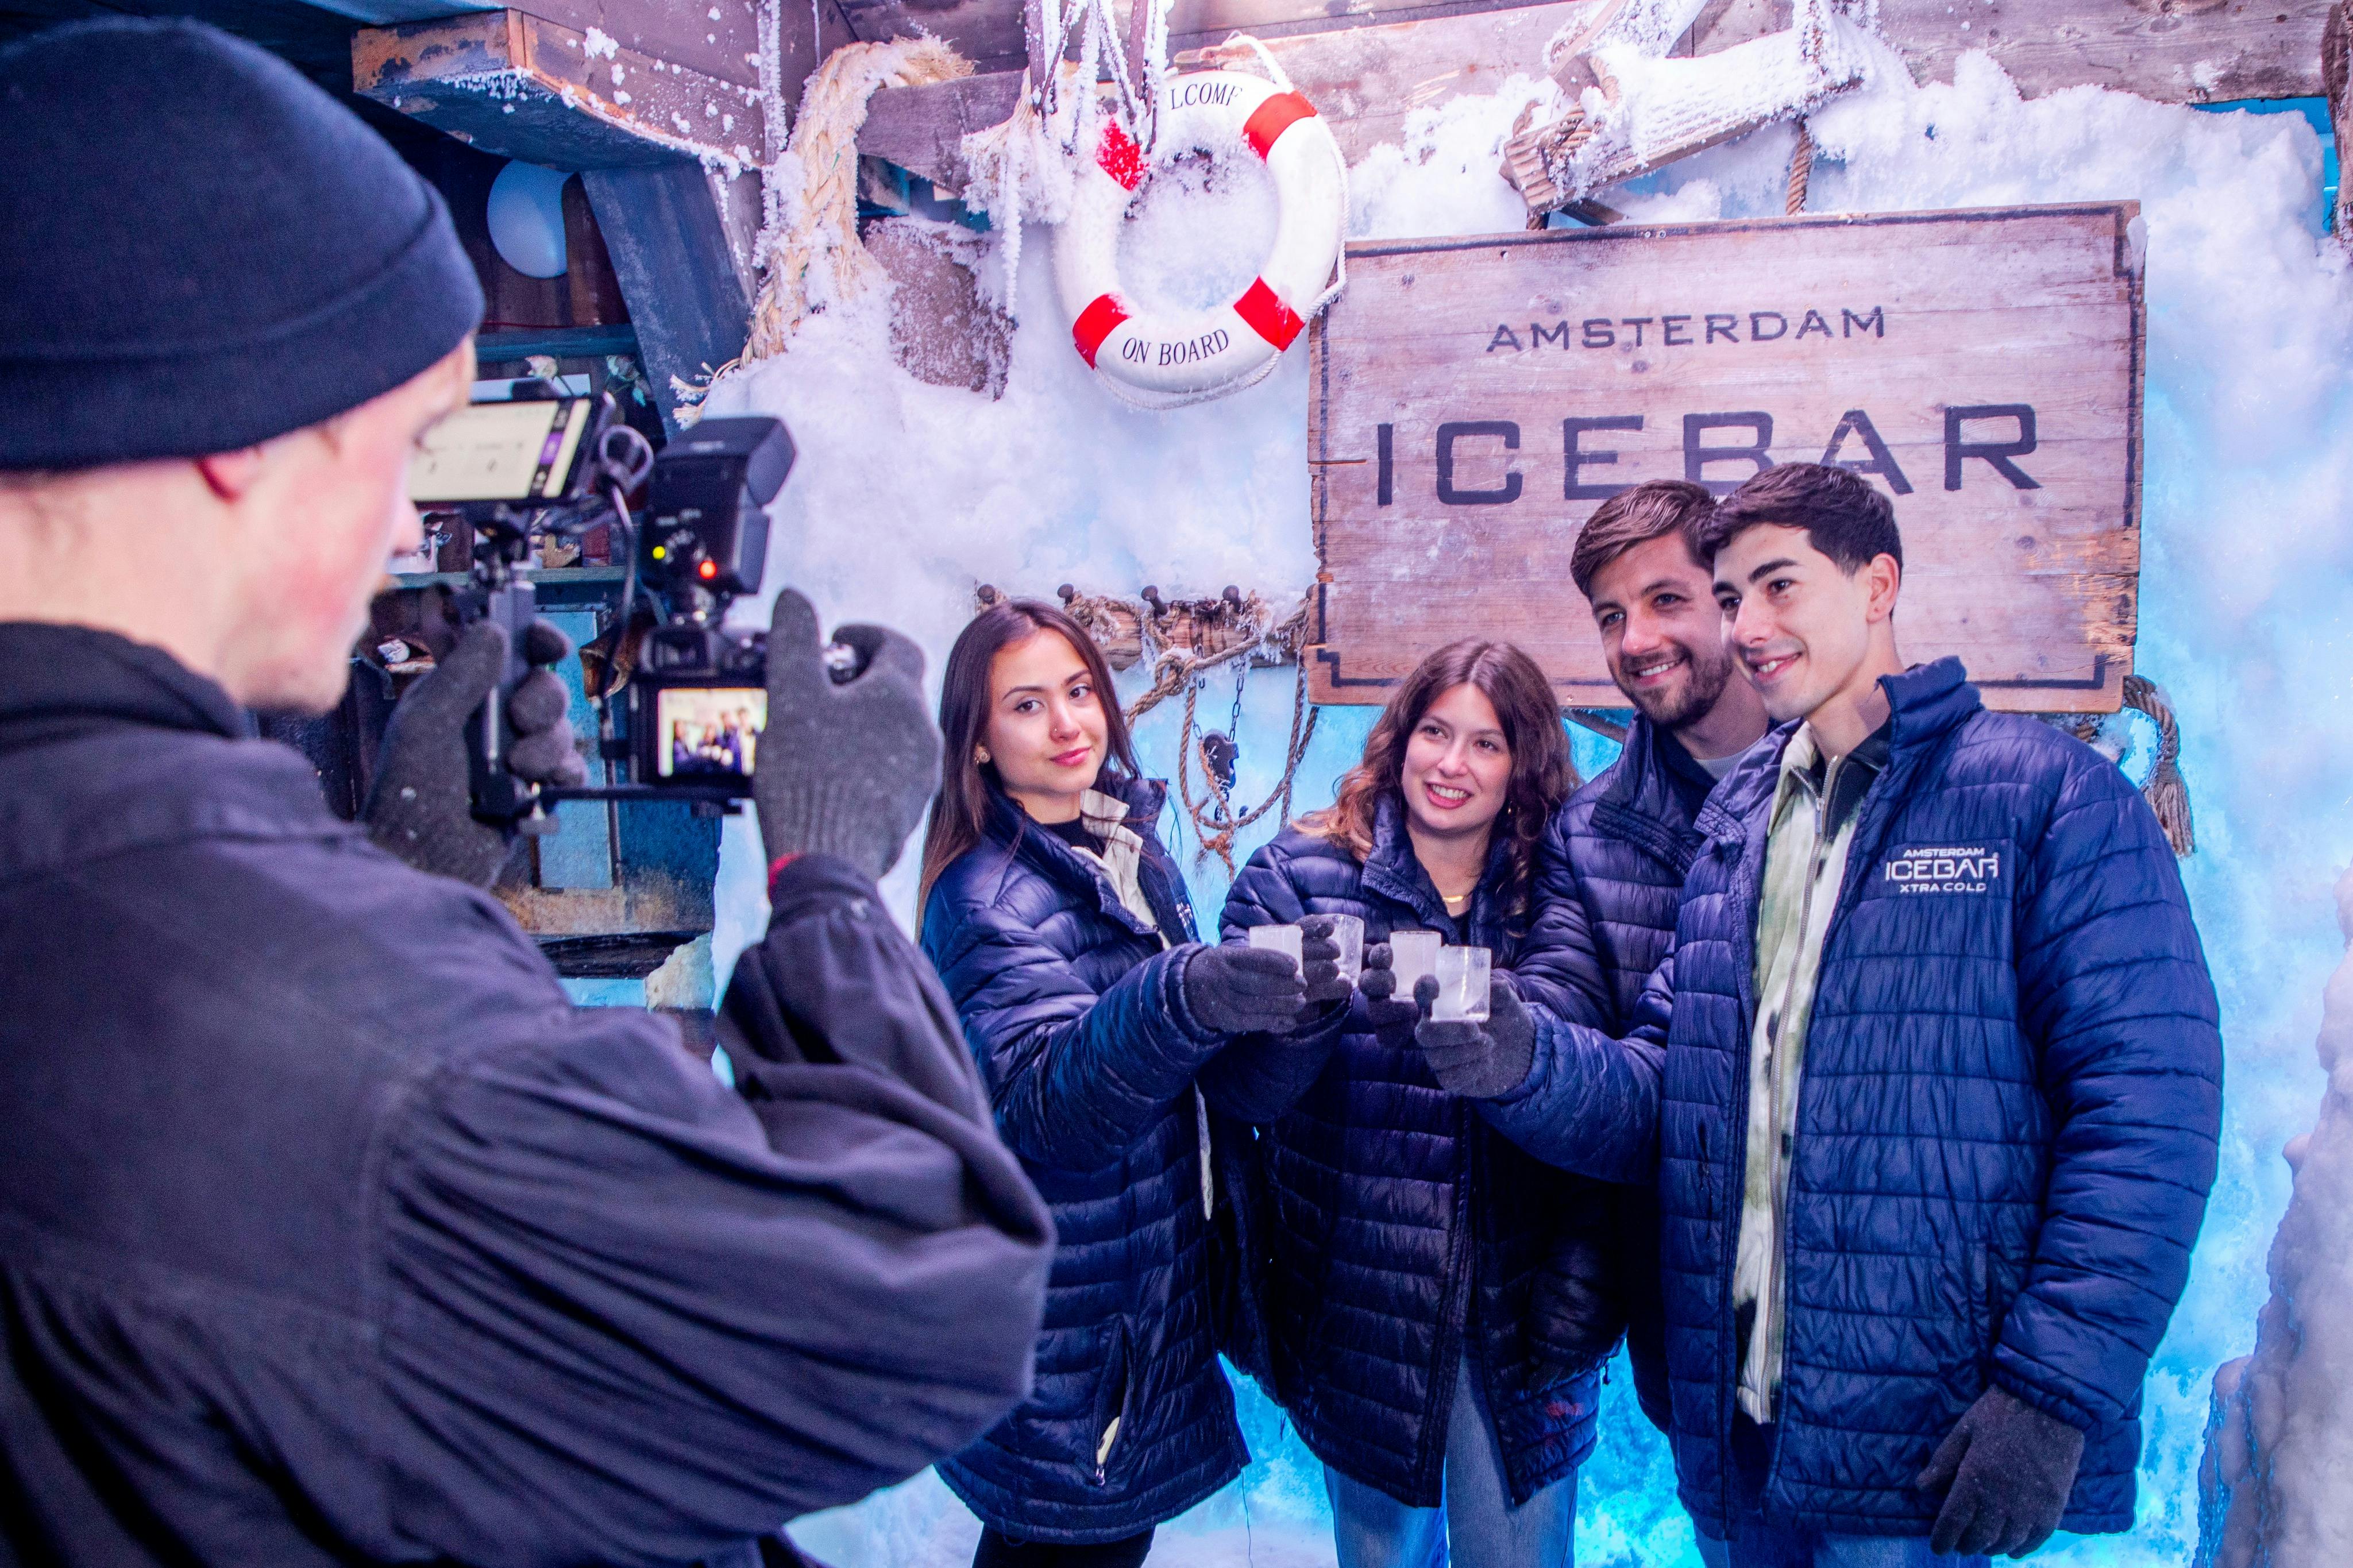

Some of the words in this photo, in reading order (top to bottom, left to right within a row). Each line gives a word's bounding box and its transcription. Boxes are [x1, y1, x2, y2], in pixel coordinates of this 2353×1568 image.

[1486, 306, 1884, 353] AMSTERDAM
[1122, 337, 1152, 364] ON
[1158, 329, 1229, 366] BOARD
[1378, 403, 2042, 507] ICEBAR
[1903, 847, 1985, 858] AMSTERDAM
[1885, 858, 2000, 882] ICEBAR
[1899, 883, 1942, 893] XTRA
[1942, 882, 1987, 893] COLD
